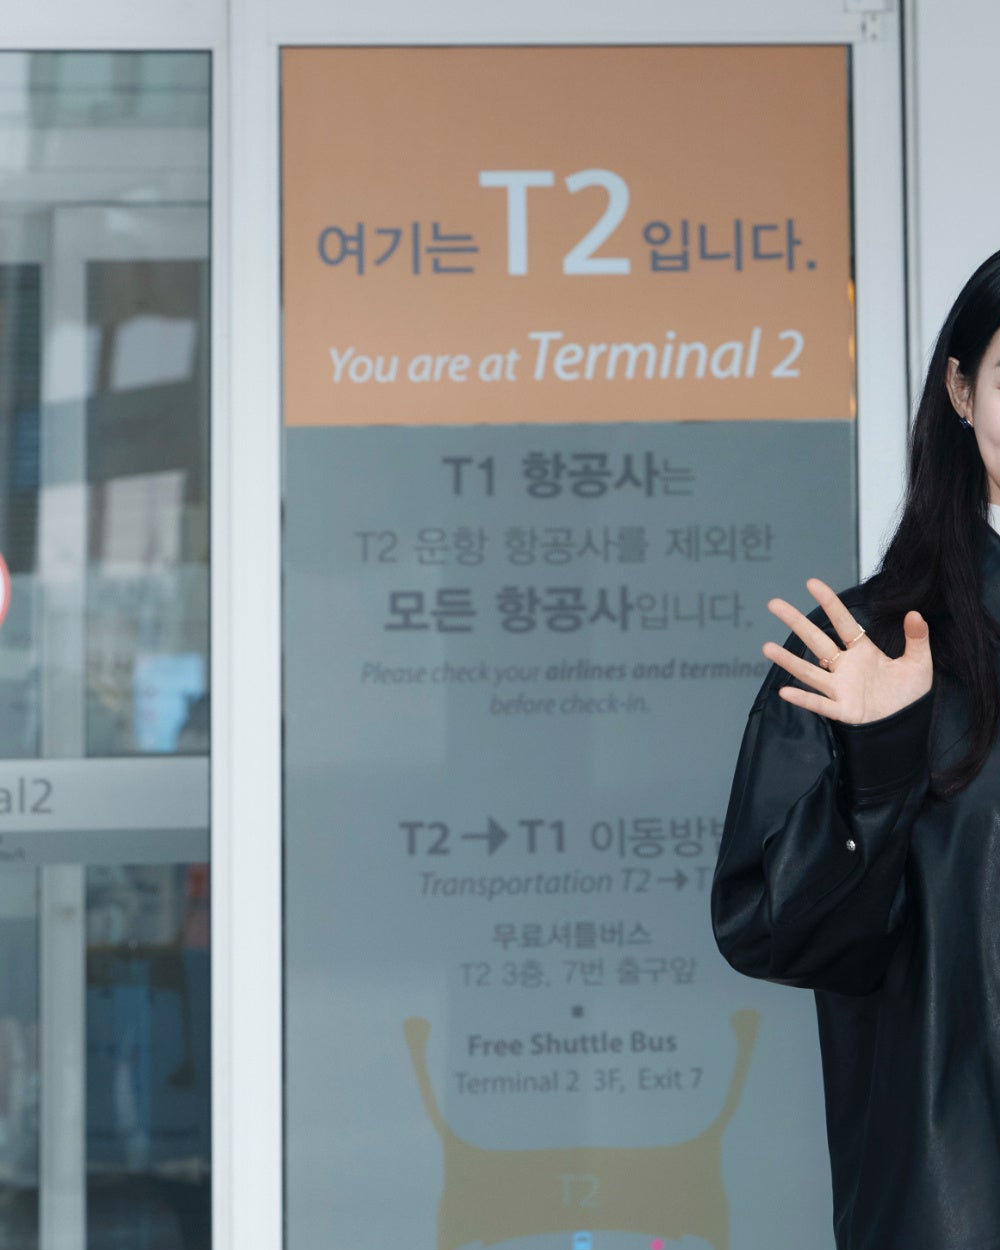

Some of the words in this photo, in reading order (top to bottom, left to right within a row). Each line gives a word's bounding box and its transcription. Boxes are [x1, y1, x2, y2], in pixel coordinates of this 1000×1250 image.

[317, 221, 479, 276] 여기는
[478, 168, 631, 276] T2
[642, 218, 817, 272] 입니다.
[329, 346, 399, 384] You
[407, 352, 470, 383] are
[478, 349, 521, 382] at
[527, 327, 762, 381] Terminal
[771, 329, 805, 379] 2
[442, 456, 496, 497] T1
[521, 451, 696, 499] 항공사는
[355, 530, 398, 564] T2
[413, 527, 486, 566] 운항
[504, 526, 650, 564] 항공사를
[665, 523, 775, 564] 제외한
[383, 587, 477, 634] 모든
[496, 585, 753, 634] 항공사입니다.
[361, 661, 427, 684] Please
[431, 660, 494, 684] check
[498, 667, 541, 688] your
[545, 657, 627, 683] airlines
[632, 657, 676, 681] and
[679, 656, 766, 680] termina
[490, 692, 554, 717] before
[399, 820, 450, 856] T2
[519, 819, 566, 854] T1
[420, 870, 613, 900] Transportation
[621, 867, 651, 893] T2
[694, 866, 712, 892] T
[492, 920, 652, 951] 무료셔틀버스
[460, 963, 491, 987] T2
[564, 960, 604, 986] 7번
[468, 1034, 522, 1057] Free
[530, 1032, 623, 1056] Shuttle
[631, 1031, 678, 1054] Bus
[454, 1069, 562, 1095] Terminal
[567, 1070, 580, 1093] 2
[638, 1066, 684, 1091] Exit
[690, 1067, 705, 1090] 7
